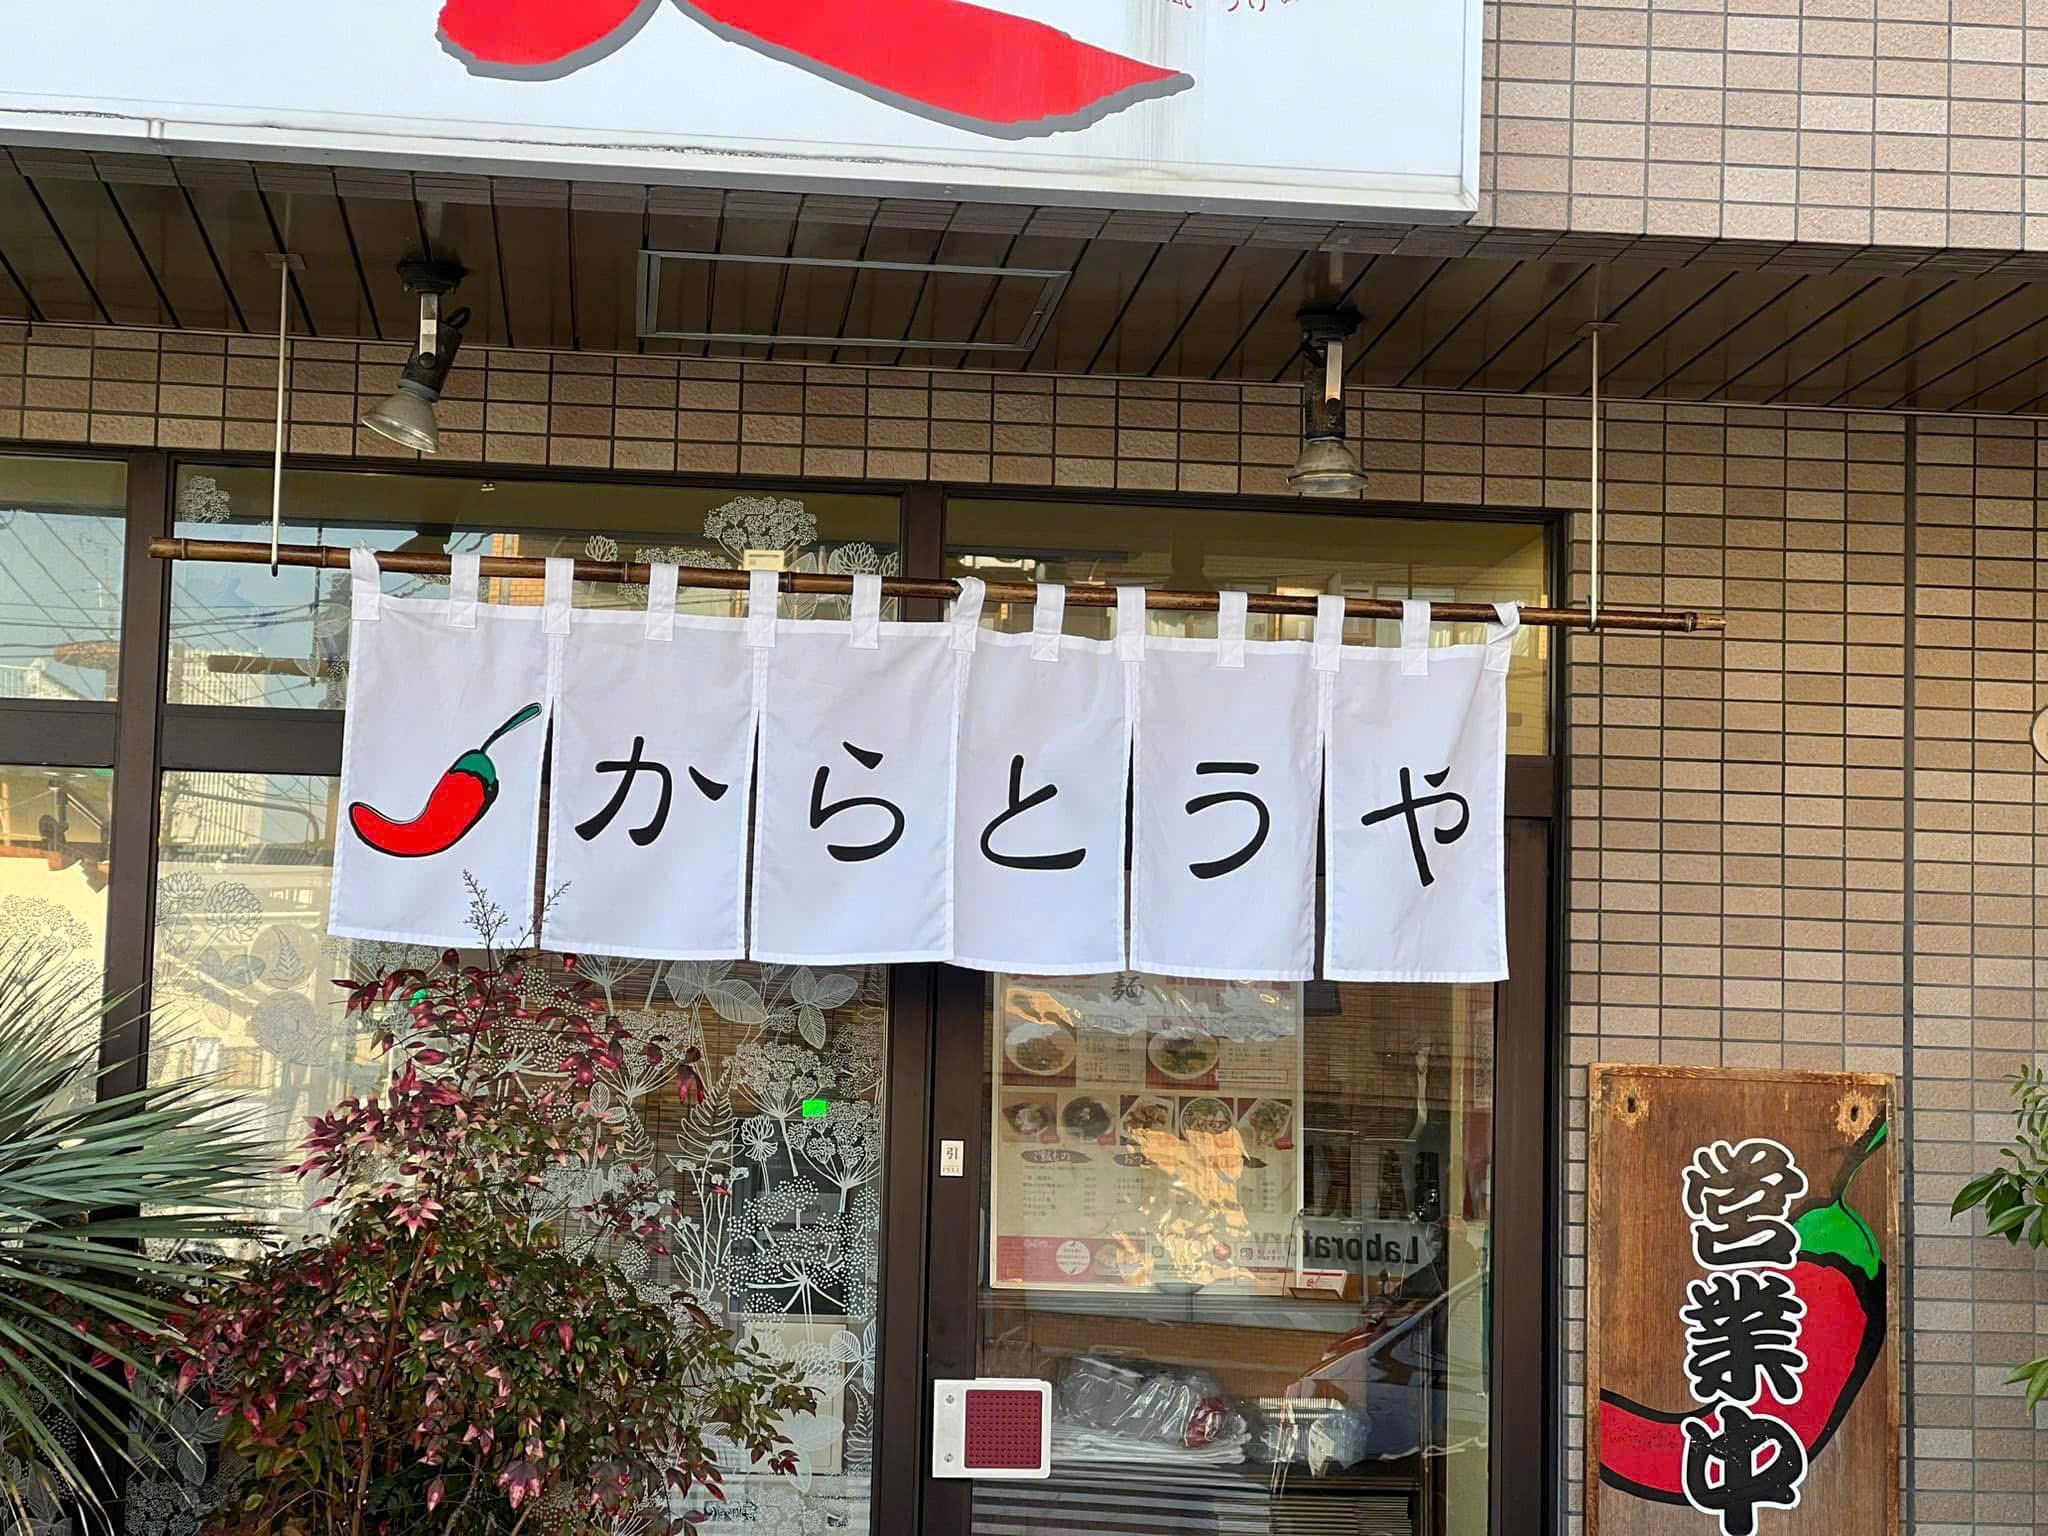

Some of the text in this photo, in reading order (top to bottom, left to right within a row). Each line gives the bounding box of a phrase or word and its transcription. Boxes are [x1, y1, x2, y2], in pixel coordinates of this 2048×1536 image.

[574, 735, 1470, 888] からとうや
[946, 1147, 958, 1160] 引
[1679, 1137, 1809, 1536] 営業中
